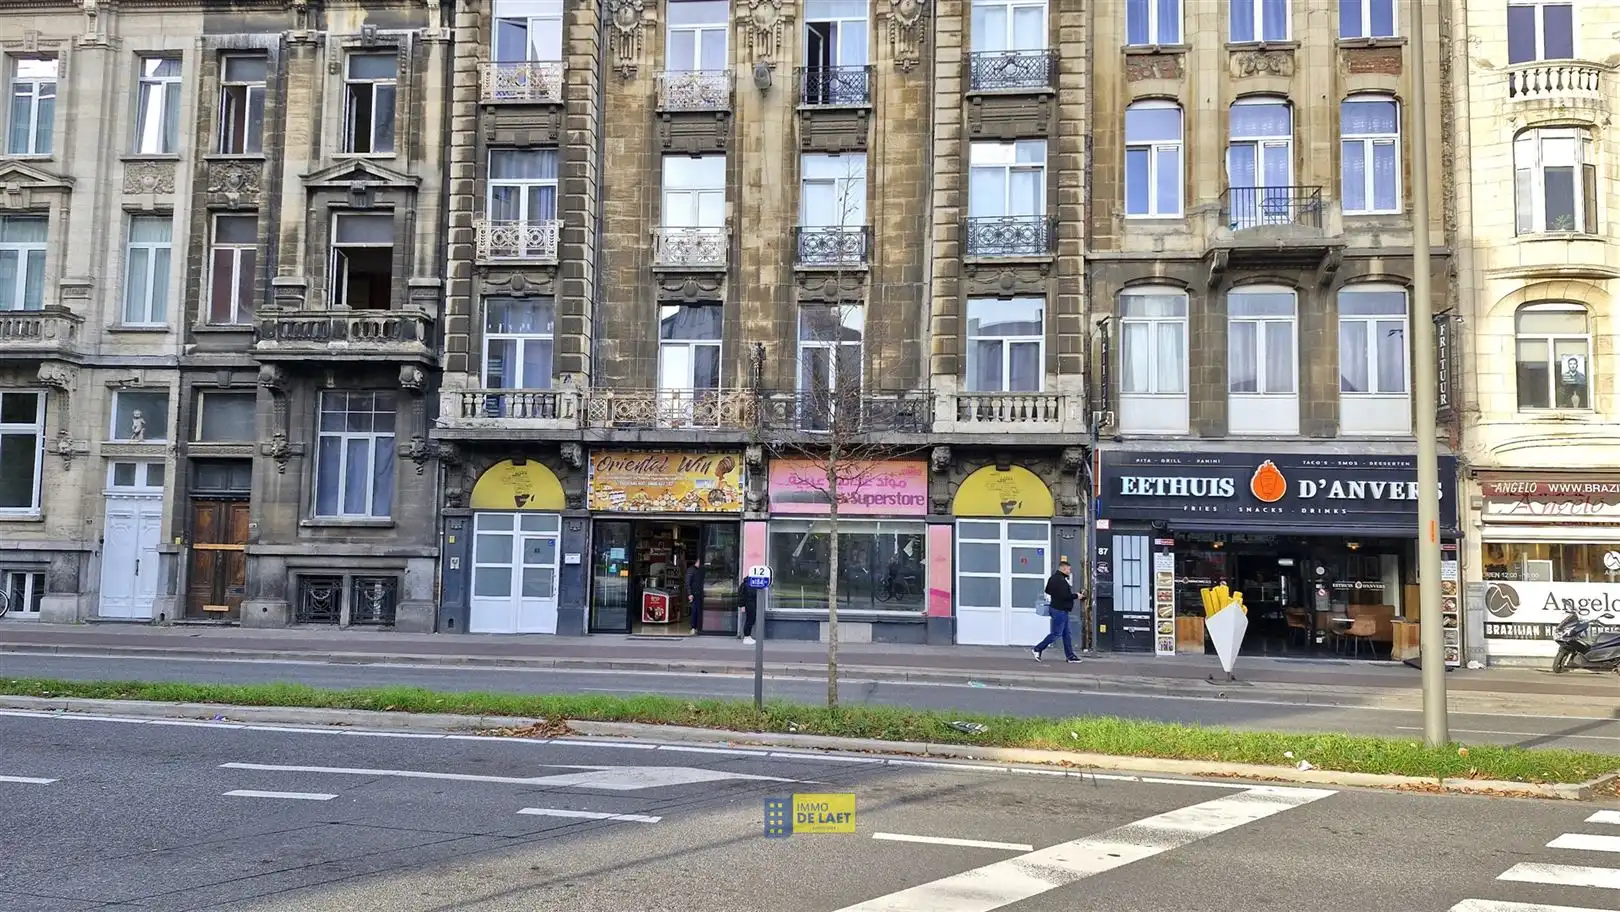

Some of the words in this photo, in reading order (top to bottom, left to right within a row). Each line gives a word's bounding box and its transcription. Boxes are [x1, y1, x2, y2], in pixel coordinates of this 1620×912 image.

[1439, 324, 1448, 405] FRITUUR
[596, 455, 669, 473] Oriental
[677, 455, 713, 474] Win
[1119, 476, 1235, 498] EETHUIS
[1495, 482, 1537, 493] ANGELO
[1098, 547, 1109, 556] 87
[1486, 623, 1540, 636] BRAZILIAN
